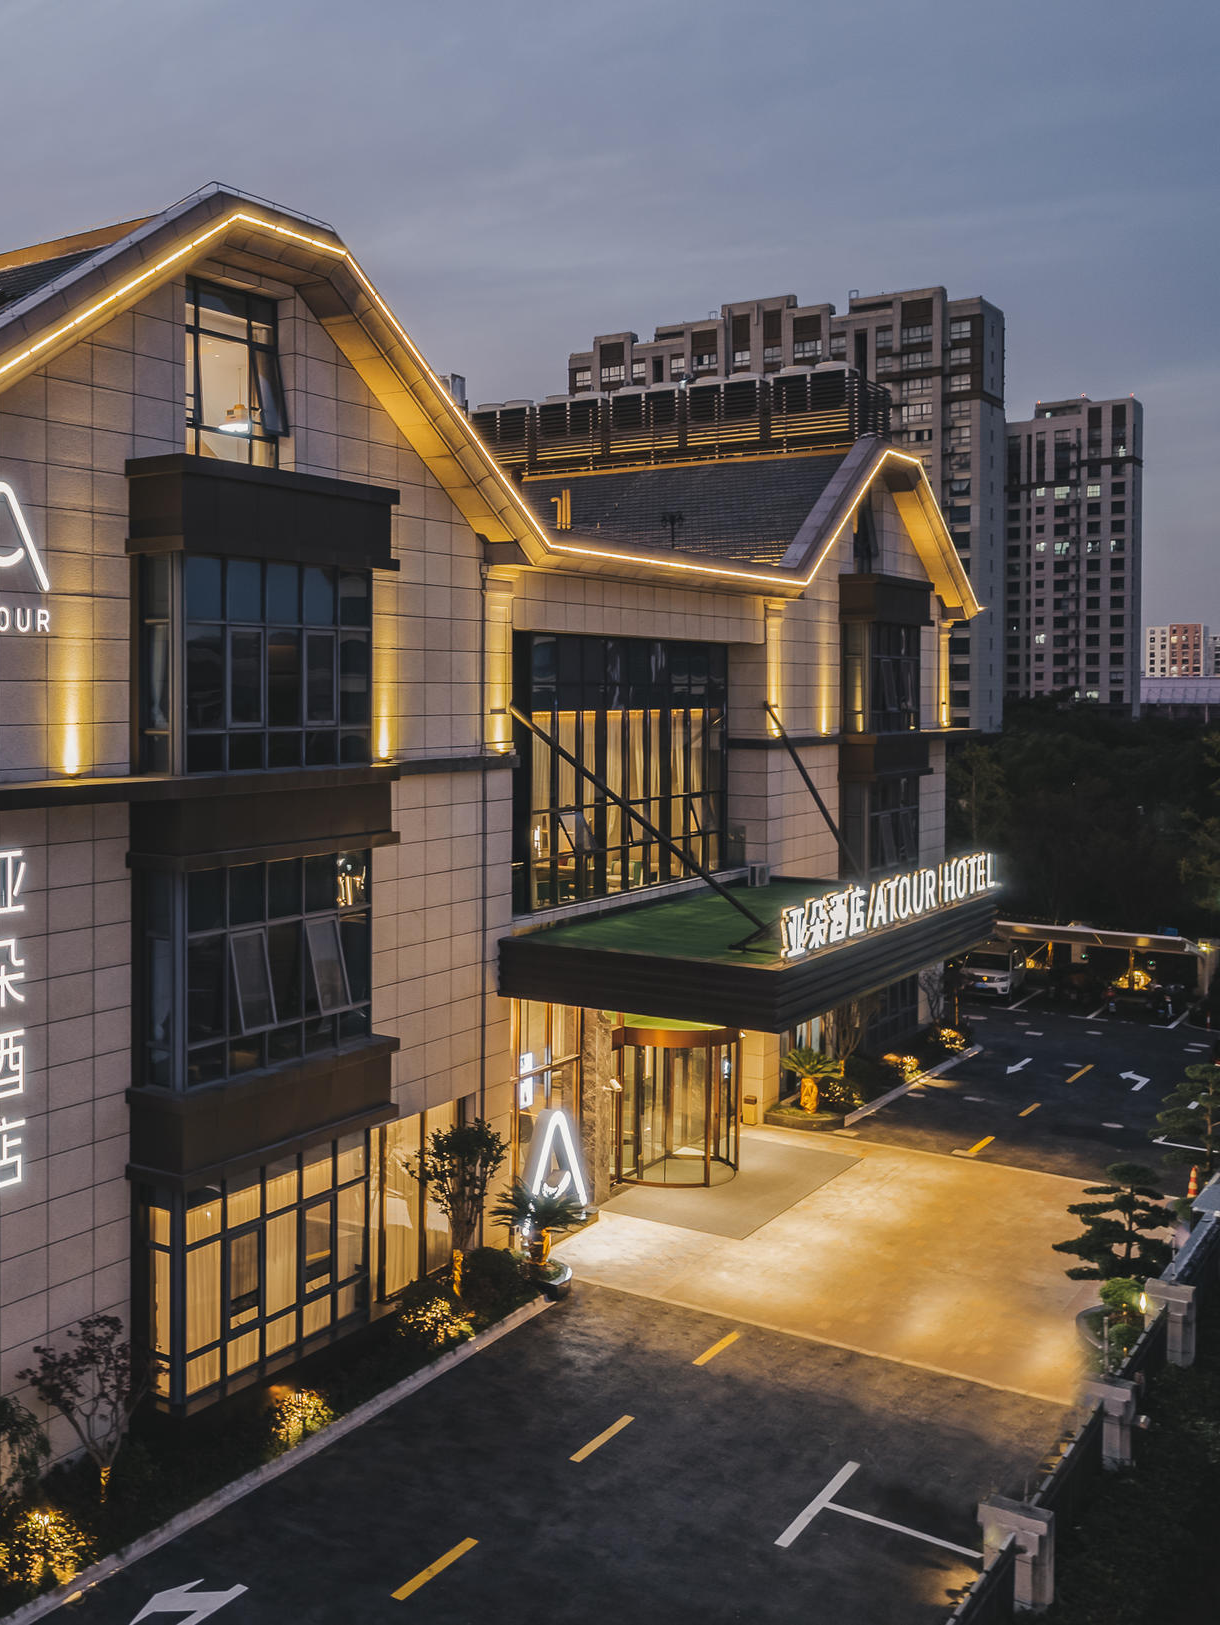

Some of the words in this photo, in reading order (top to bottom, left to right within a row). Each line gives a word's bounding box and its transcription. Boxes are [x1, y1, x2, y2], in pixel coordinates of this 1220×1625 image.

[783, 885, 868, 958] 亚朵酒店
[872, 868, 937, 929] ATOUR
[943, 852, 997, 903] HOTEL
